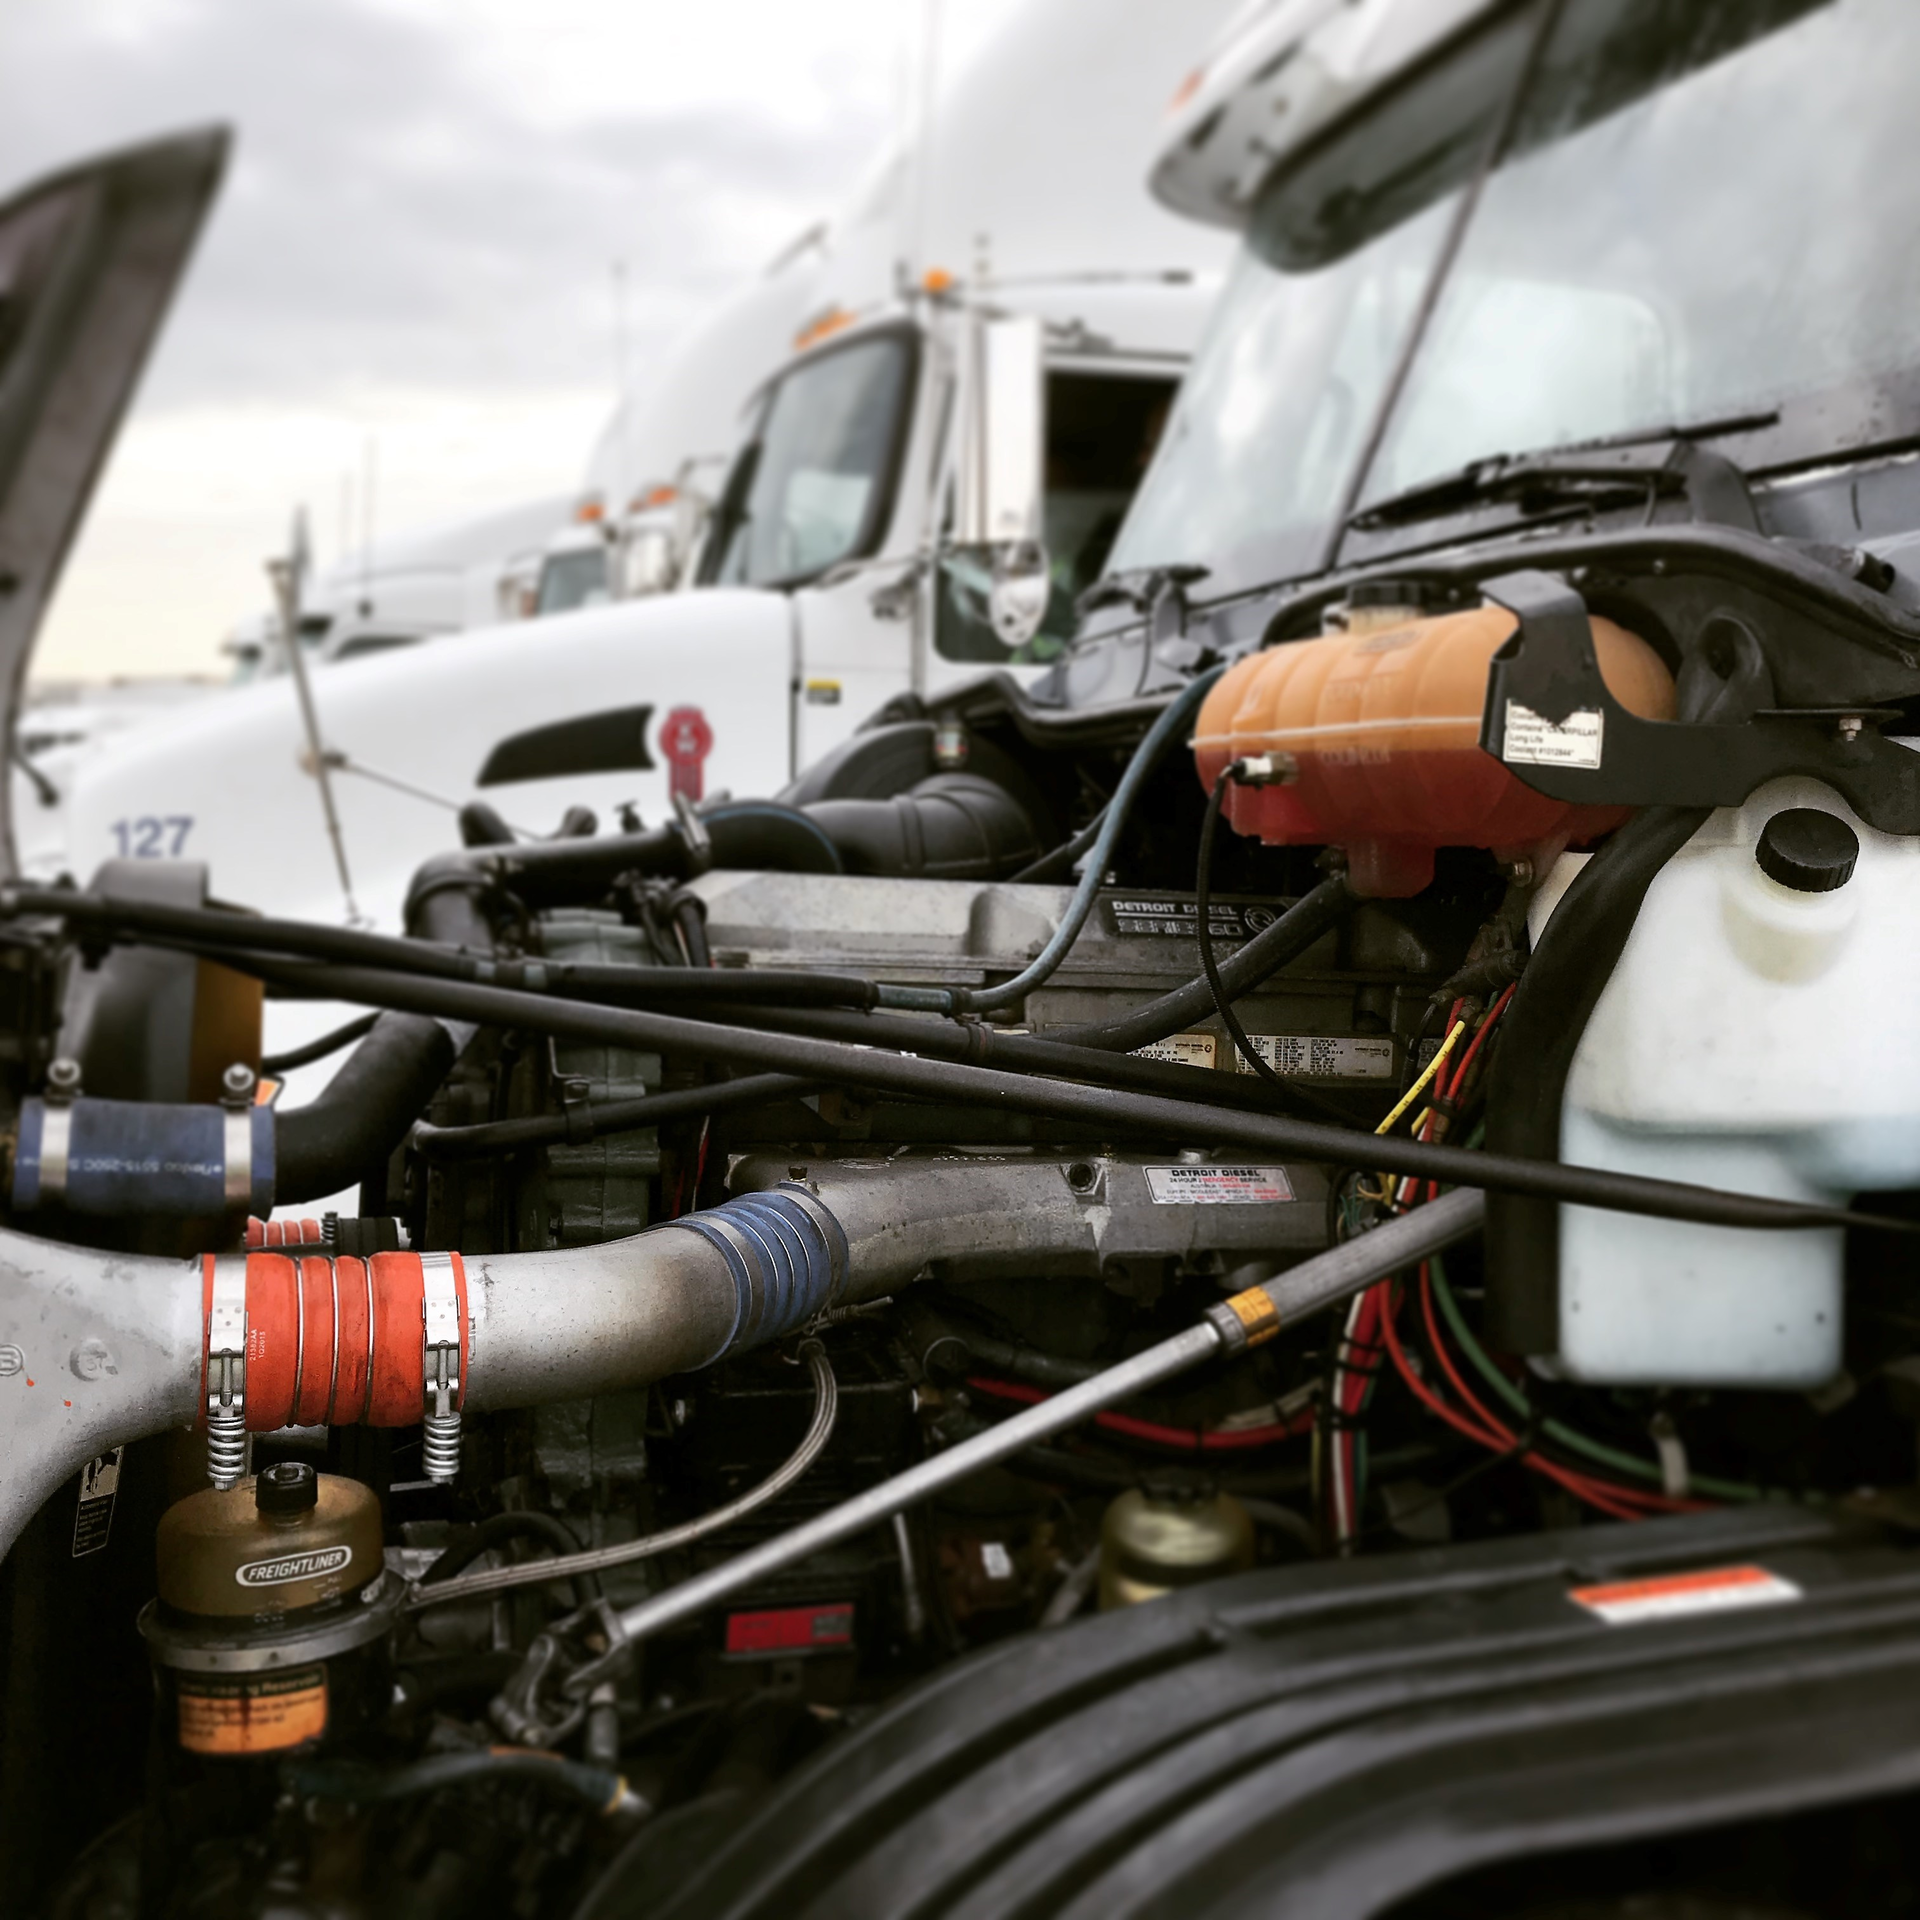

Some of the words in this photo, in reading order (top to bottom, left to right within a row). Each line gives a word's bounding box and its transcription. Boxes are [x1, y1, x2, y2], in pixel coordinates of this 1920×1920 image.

[1510, 734, 1528, 743] Long
[1530, 735, 1543, 744] Life
[1510, 744, 1537, 754] Coolant
[109, 817, 194, 858] 127
[1112, 901, 1176, 913] DETROIT
[1182, 903, 1237, 915] DISEL
[1208, 922, 1244, 936] 60
[1172, 1169, 1217, 1177] DETROIT
[1221, 1169, 1260, 1177] DIESEL
[248, 1552, 342, 1580] FREIGHTLINER
